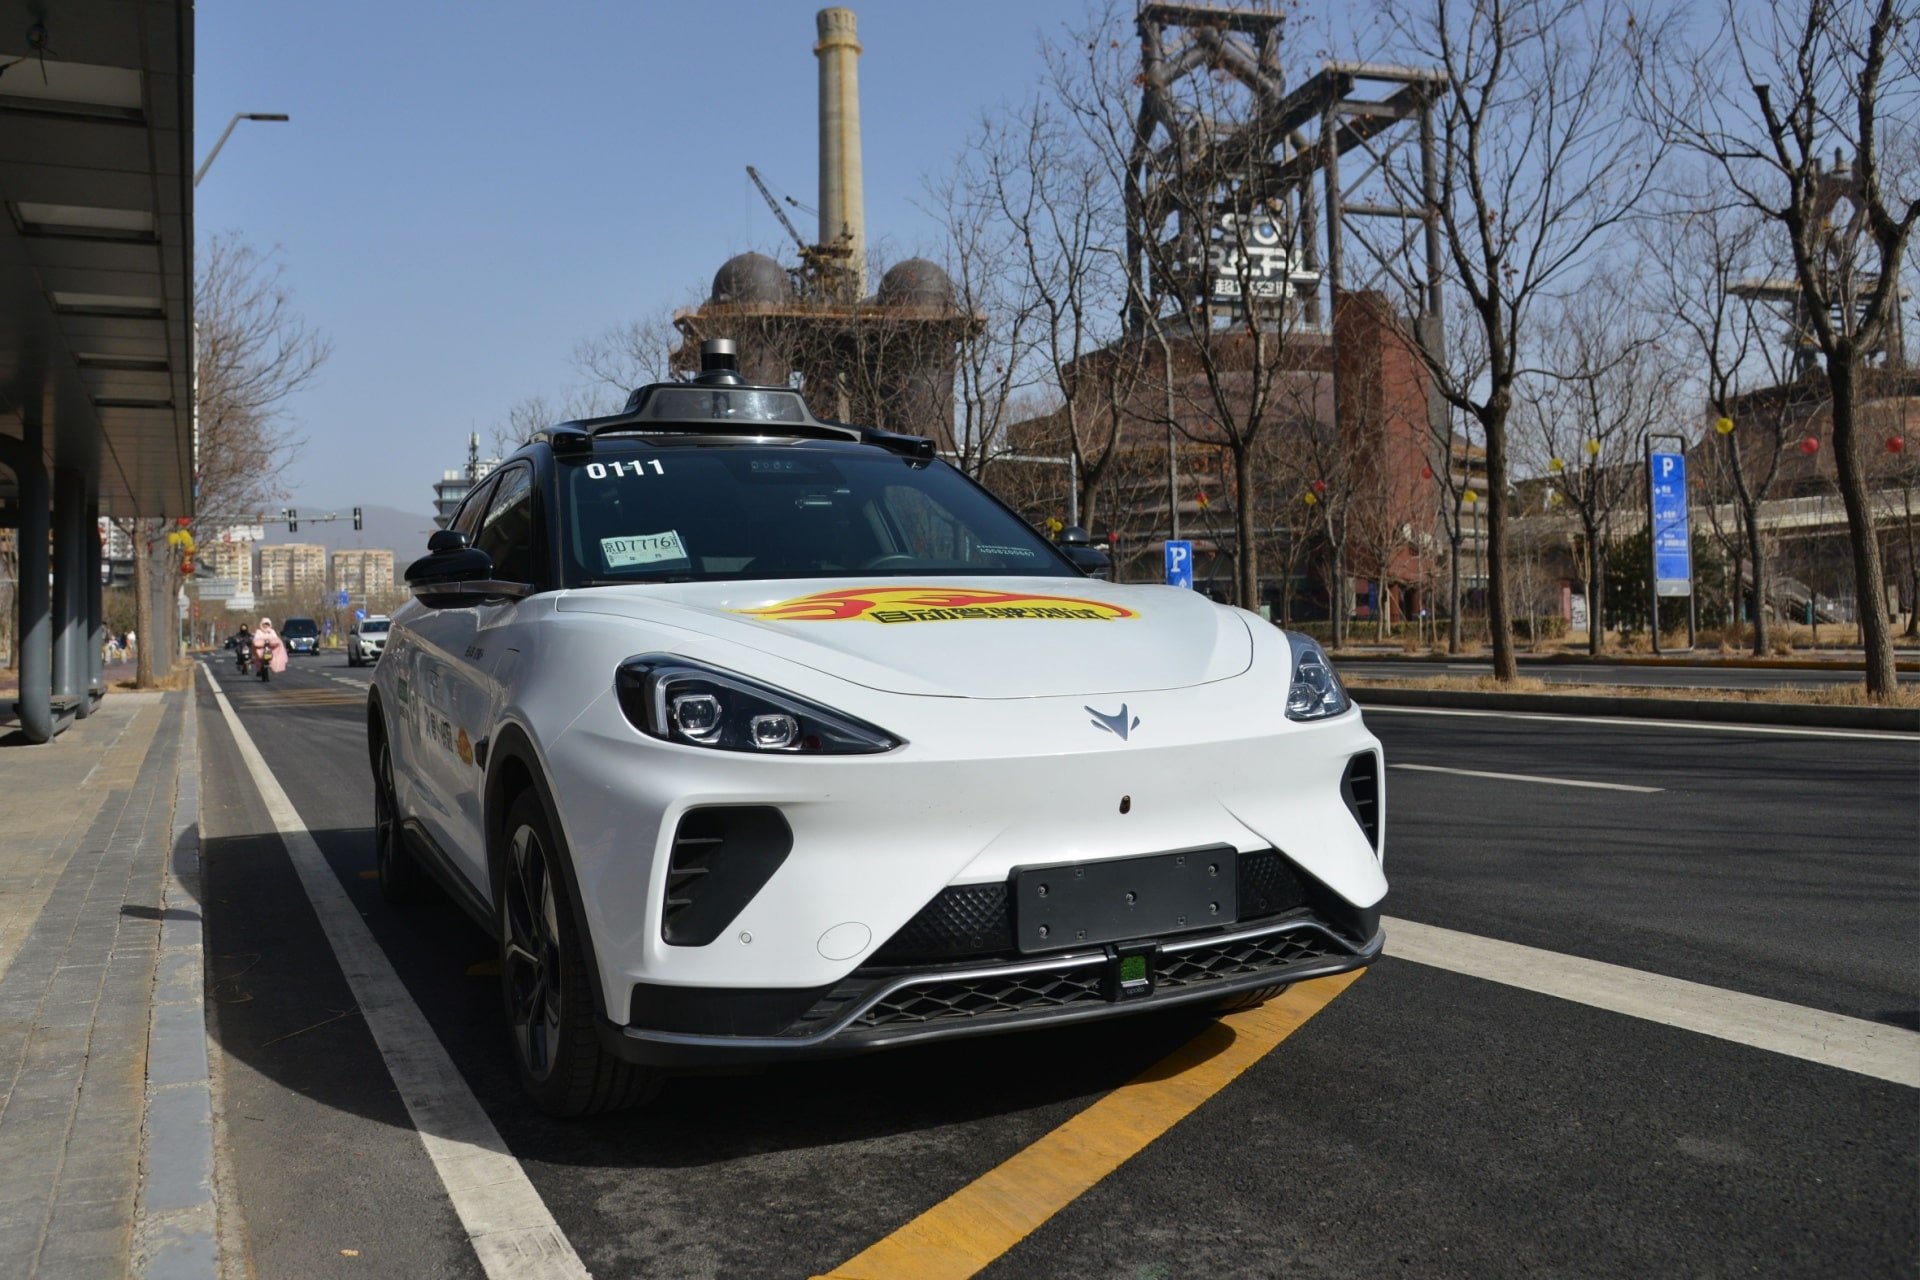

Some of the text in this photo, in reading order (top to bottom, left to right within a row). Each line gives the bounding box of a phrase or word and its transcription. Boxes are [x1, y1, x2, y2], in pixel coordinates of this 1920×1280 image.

[586, 459, 665, 479] 0111
[1662, 457, 1674, 477] P
[1170, 547, 1187, 573] P
[869, 606, 1113, 624] 自动驾驶测试
